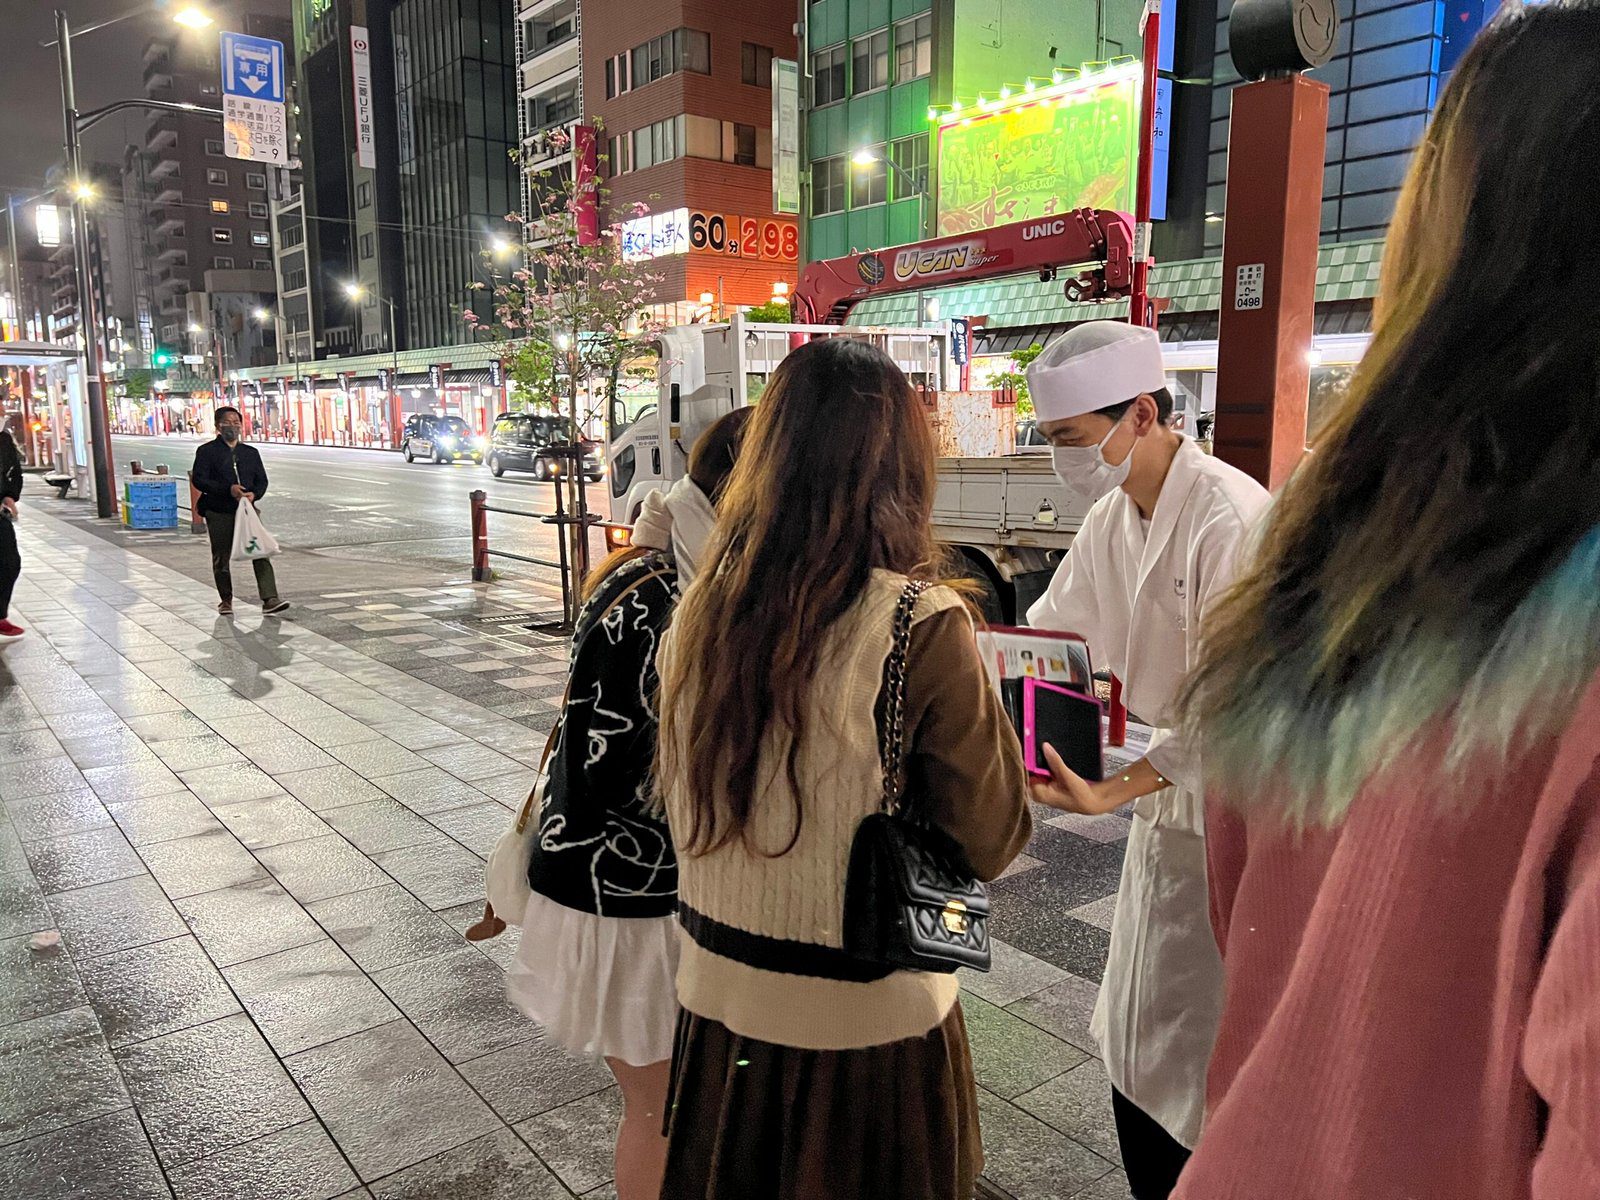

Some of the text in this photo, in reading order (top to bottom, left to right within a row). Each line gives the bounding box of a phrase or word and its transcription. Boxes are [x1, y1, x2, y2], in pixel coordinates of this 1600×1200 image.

[358, 76, 370, 143] 三菱UFJ銀行
[1022, 219, 1065, 240] UNIC
[895, 246, 999, 279] UCAN Super
[1237, 297, 1260, 308] 0498
